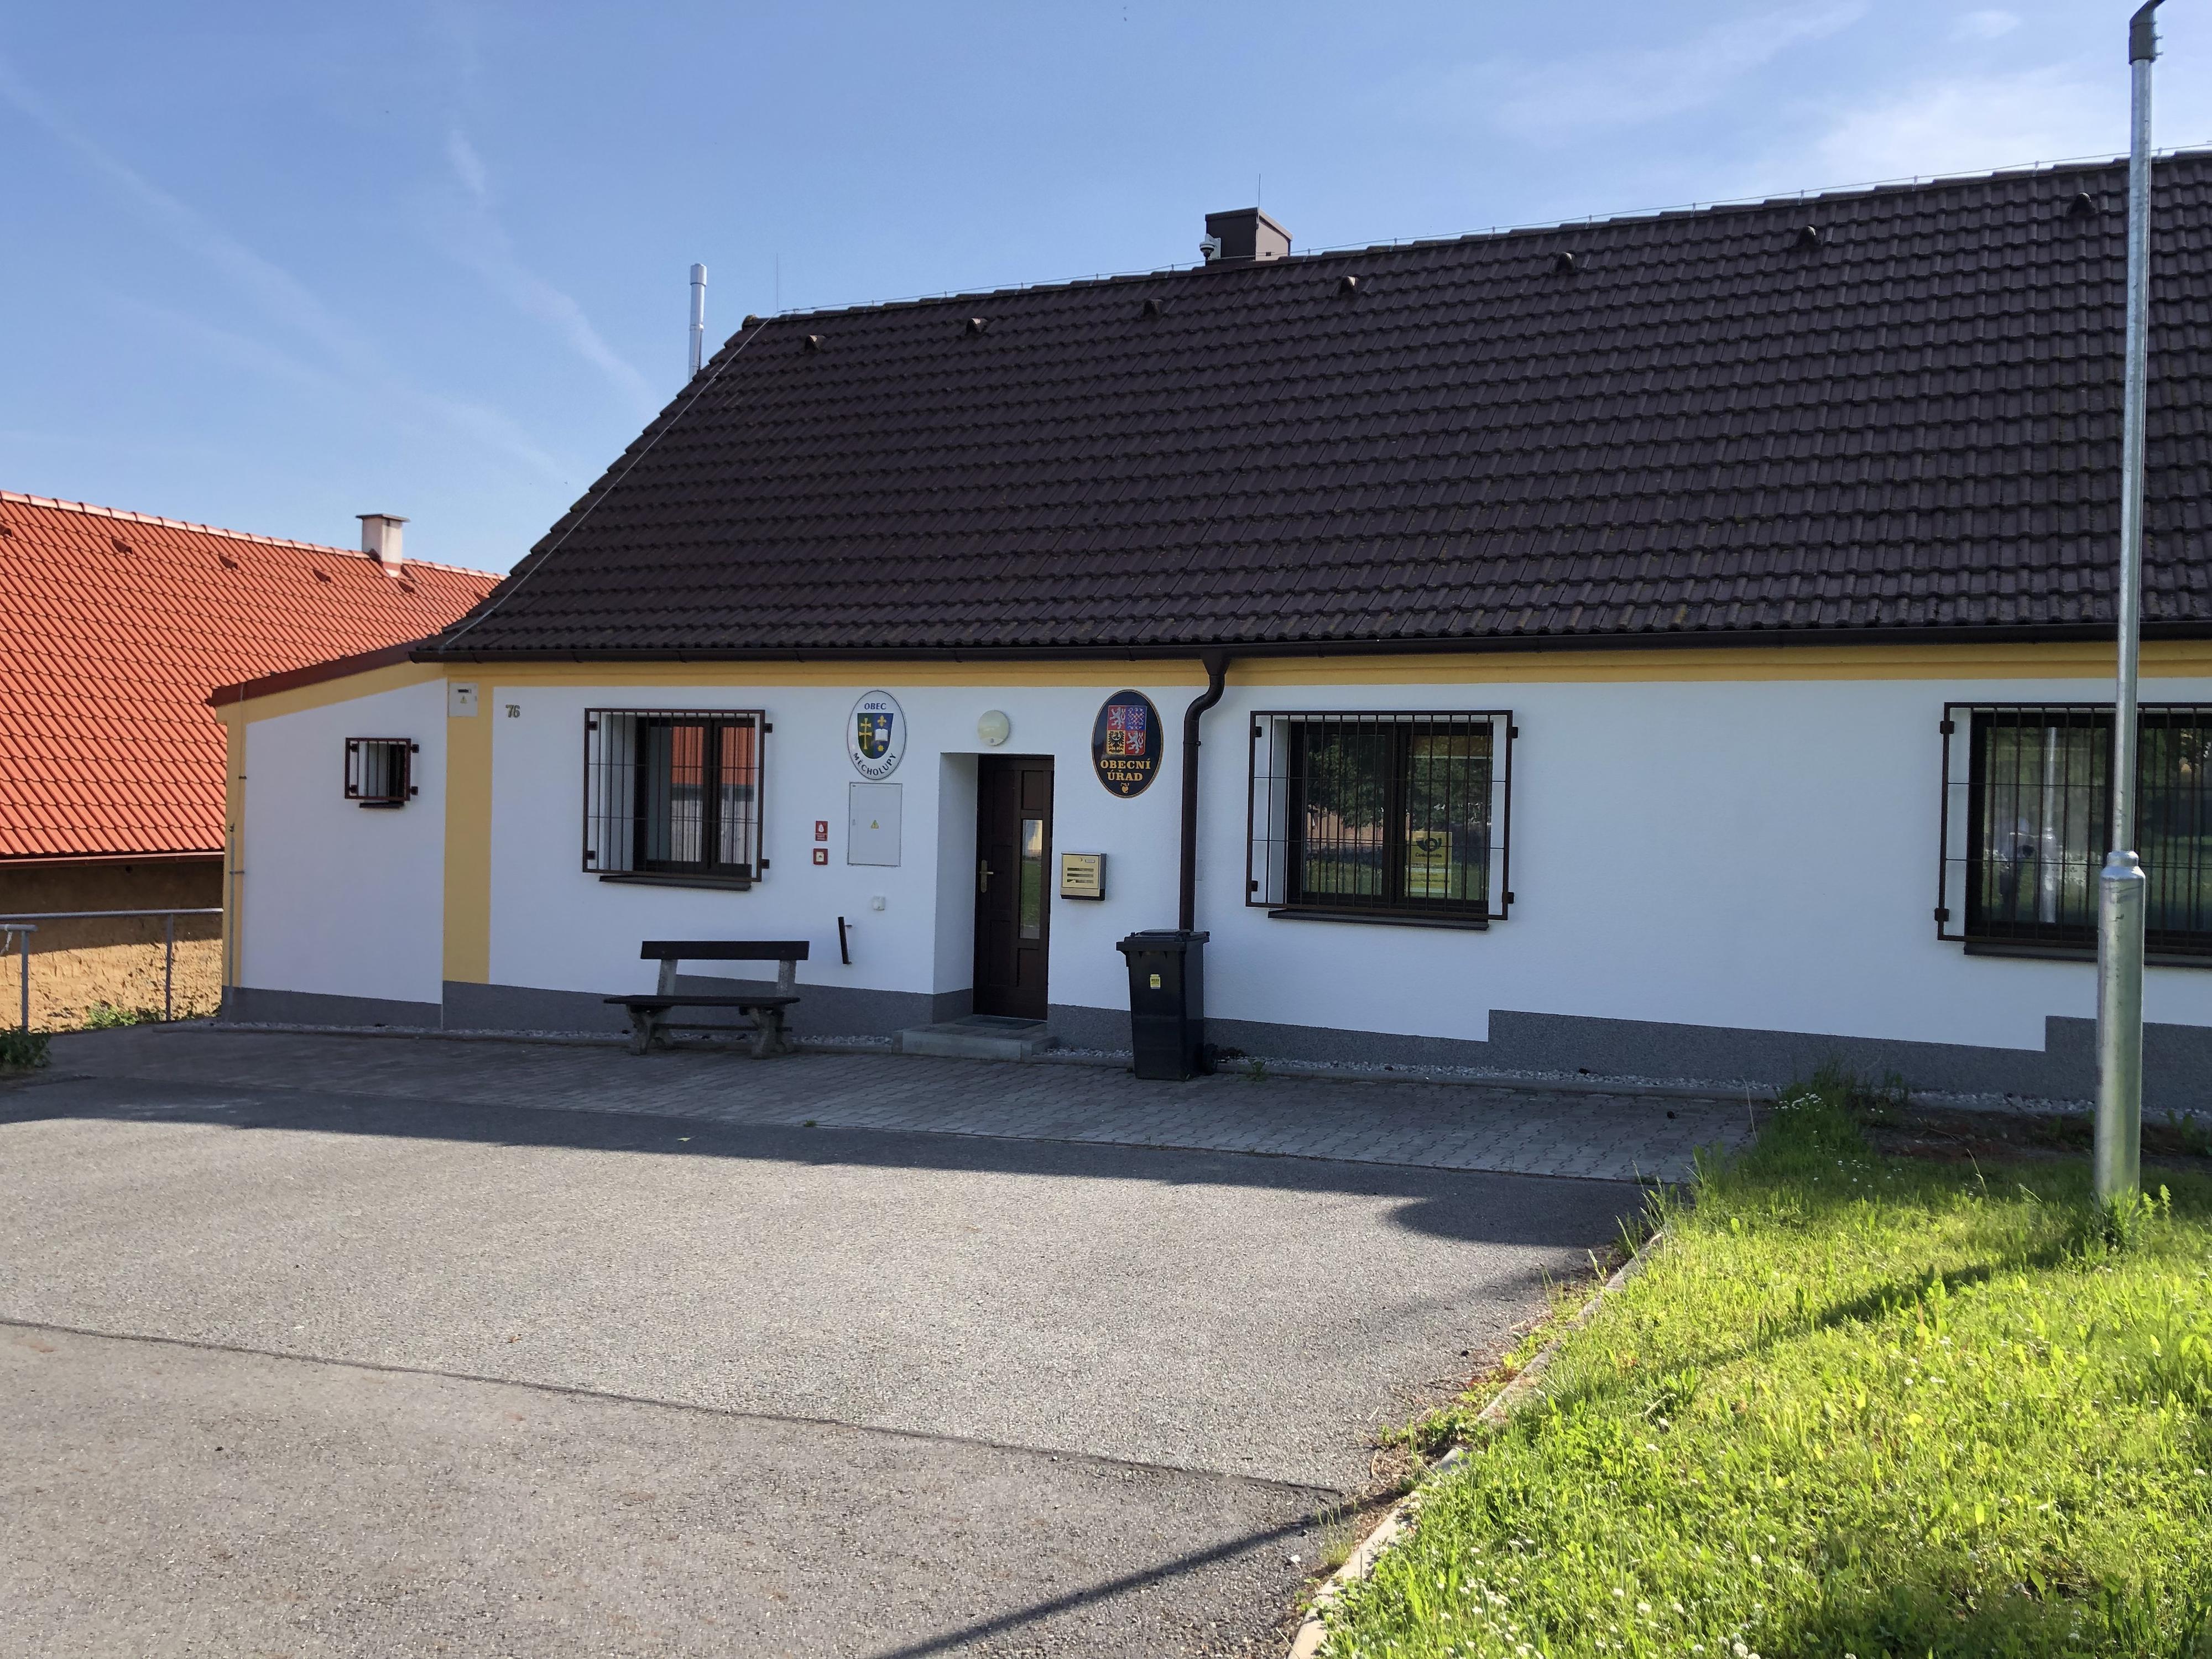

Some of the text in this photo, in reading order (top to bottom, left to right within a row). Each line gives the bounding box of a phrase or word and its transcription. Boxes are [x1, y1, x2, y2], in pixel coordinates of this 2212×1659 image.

[505, 705, 520, 718] 76
[854, 753, 896, 775] MĚCHOLUPY
[1100, 758, 1150, 769] OBECNÍ
[1107, 770, 1143, 781] ÚŘAD
